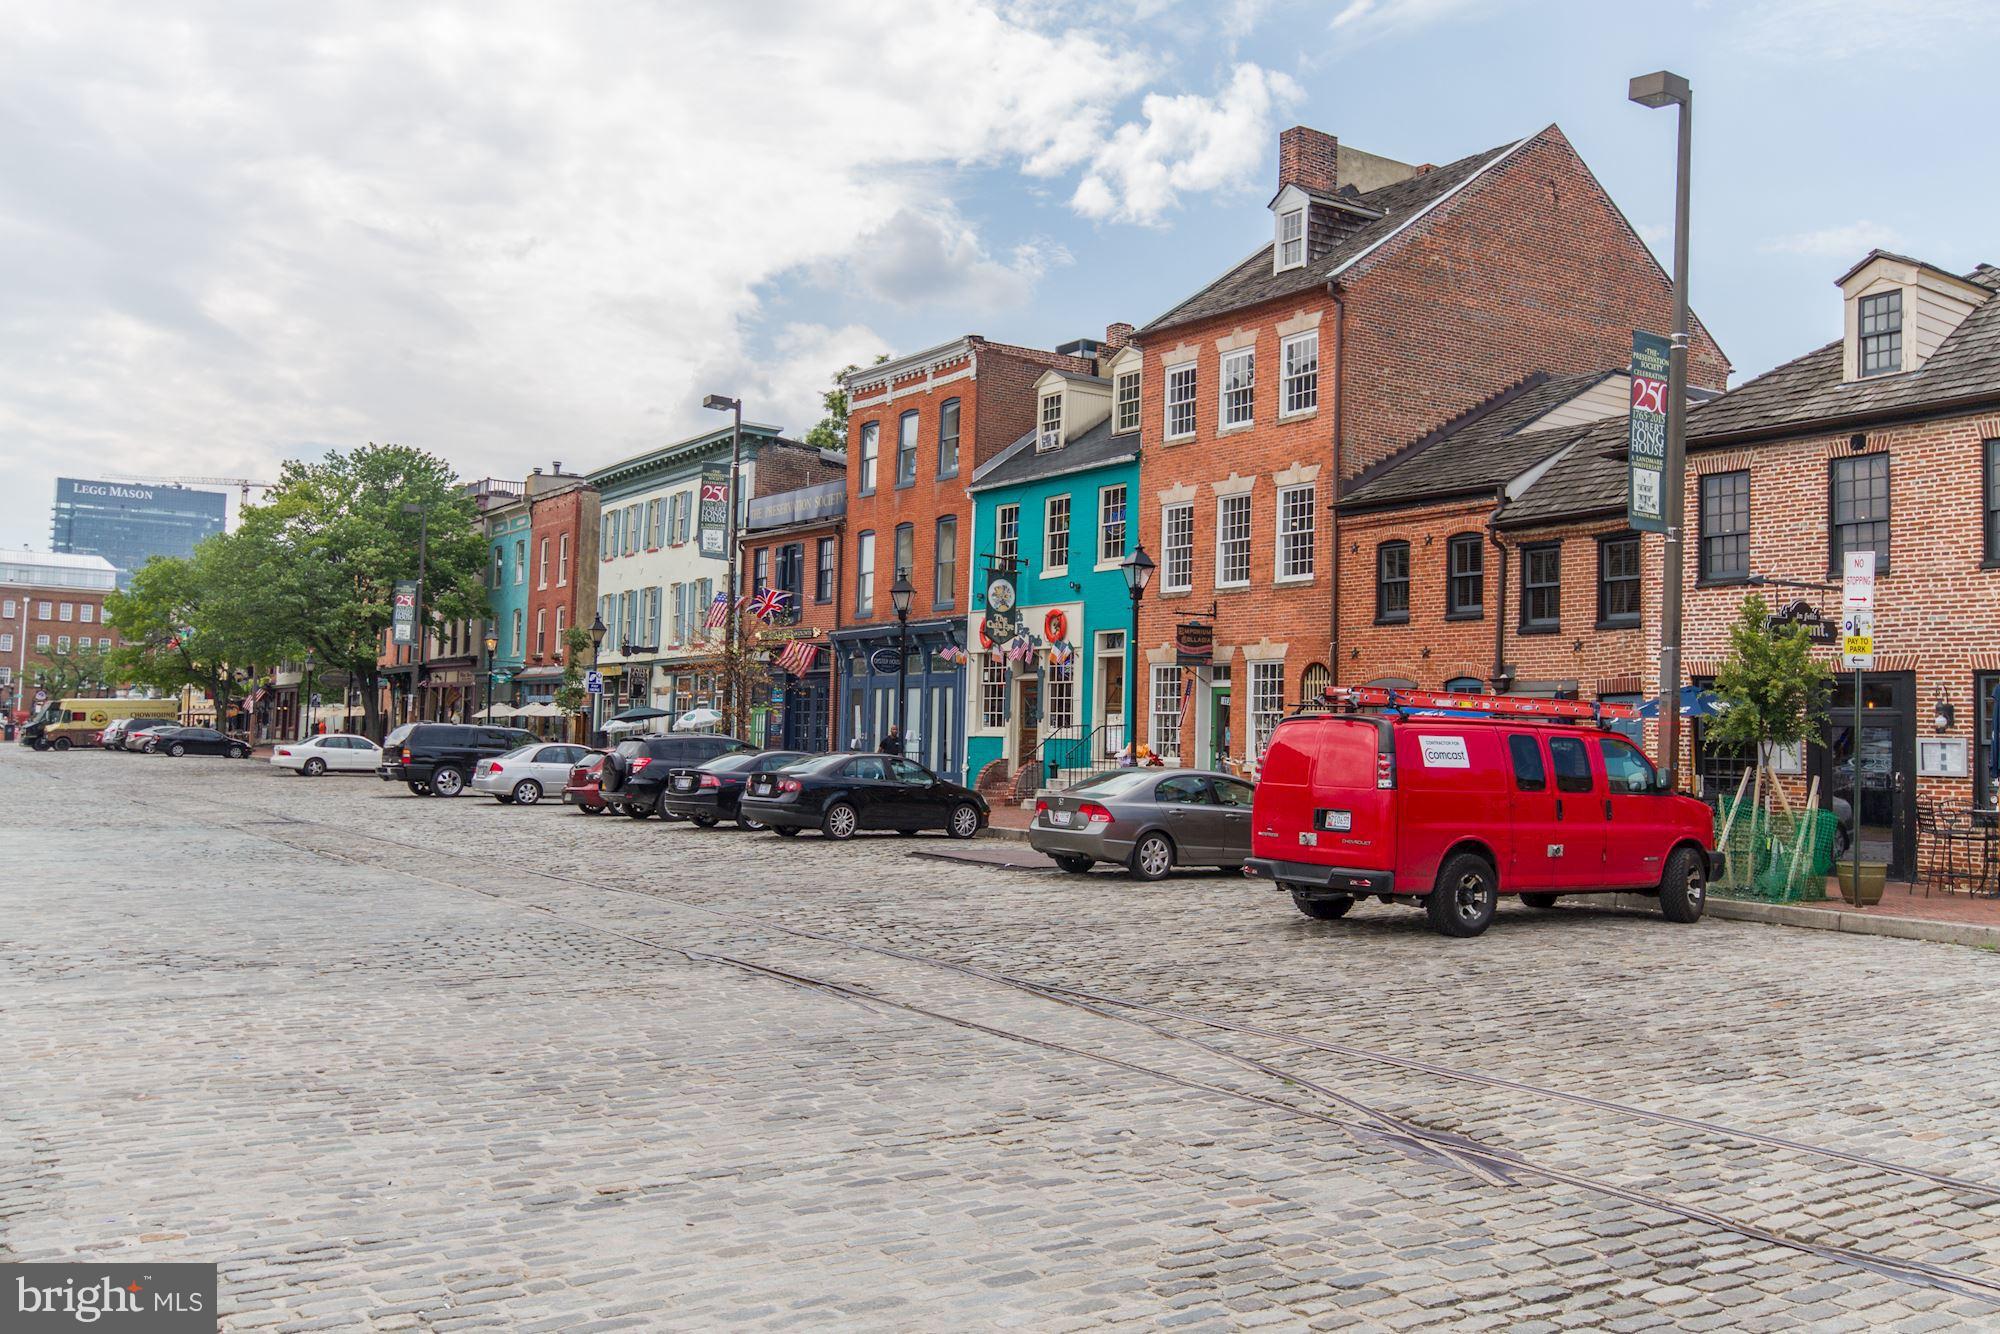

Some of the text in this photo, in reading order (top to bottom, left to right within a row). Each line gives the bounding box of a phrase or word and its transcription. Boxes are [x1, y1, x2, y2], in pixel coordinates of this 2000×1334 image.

[1633, 351, 1670, 367] PRESERVATION
[1641, 360, 1664, 373] SOCIETY
[1633, 369, 1668, 382] CELEBRATING
[1632, 410, 1666, 424] 1765-2015
[1632, 419, 1665, 434] ROBERT
[1632, 428, 1665, 447] LONG
[1632, 441, 1665, 457] HOUSE
[73, 482, 153, 500] LEGG MASON
[701, 516, 727, 524] HOUSE
[1854, 559, 1865, 568] NO
[1847, 576, 1871, 586] STOPPING
[1847, 638, 1869, 646] PAY TO
[1849, 645, 1866, 653] PARK
[130, 711, 176, 719] CHOWHOUND
